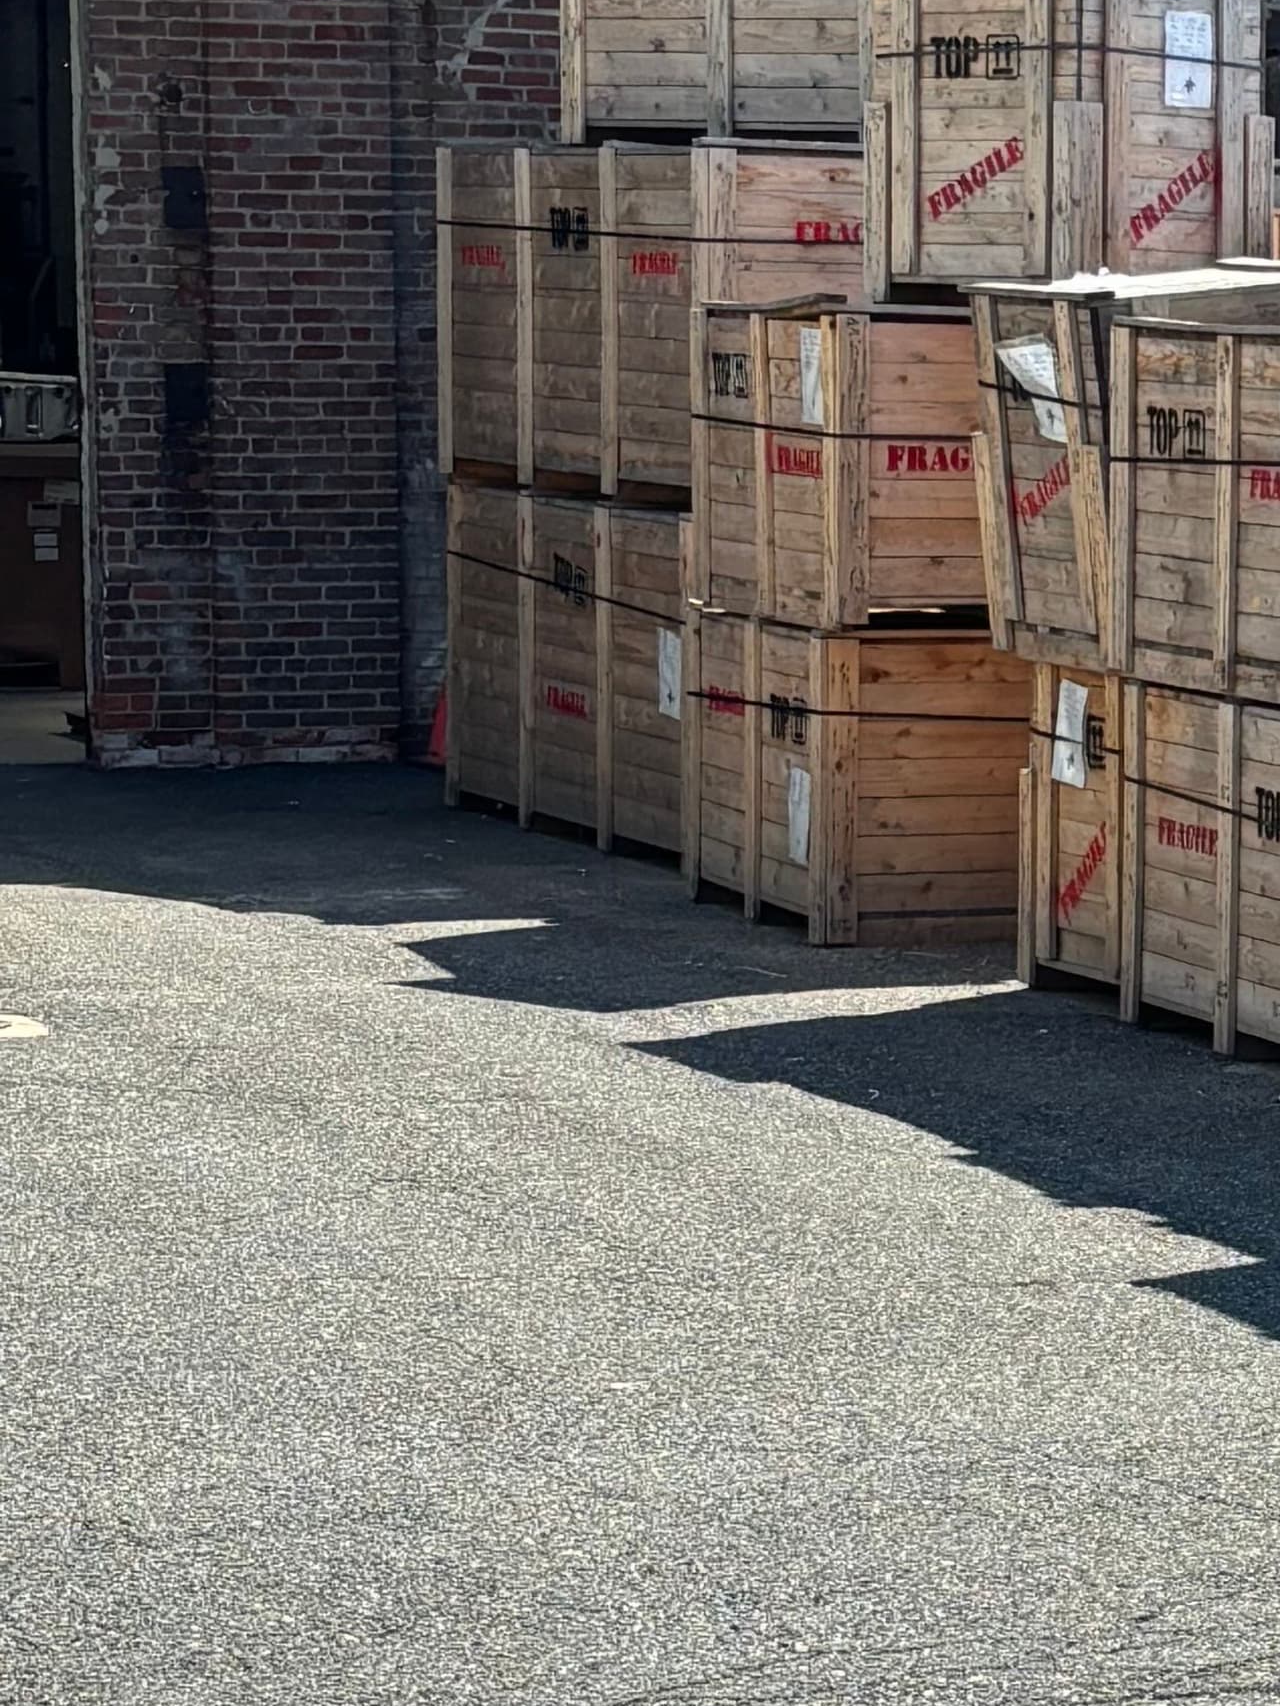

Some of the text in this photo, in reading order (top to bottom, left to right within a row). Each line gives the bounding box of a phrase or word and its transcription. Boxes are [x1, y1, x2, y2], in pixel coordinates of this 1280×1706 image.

[930, 36, 979, 78] TOP
[927, 136, 1024, 221] FRAGILE
[1129, 150, 1218, 246] FRAGILE
[1147, 405, 1179, 457] TOP
